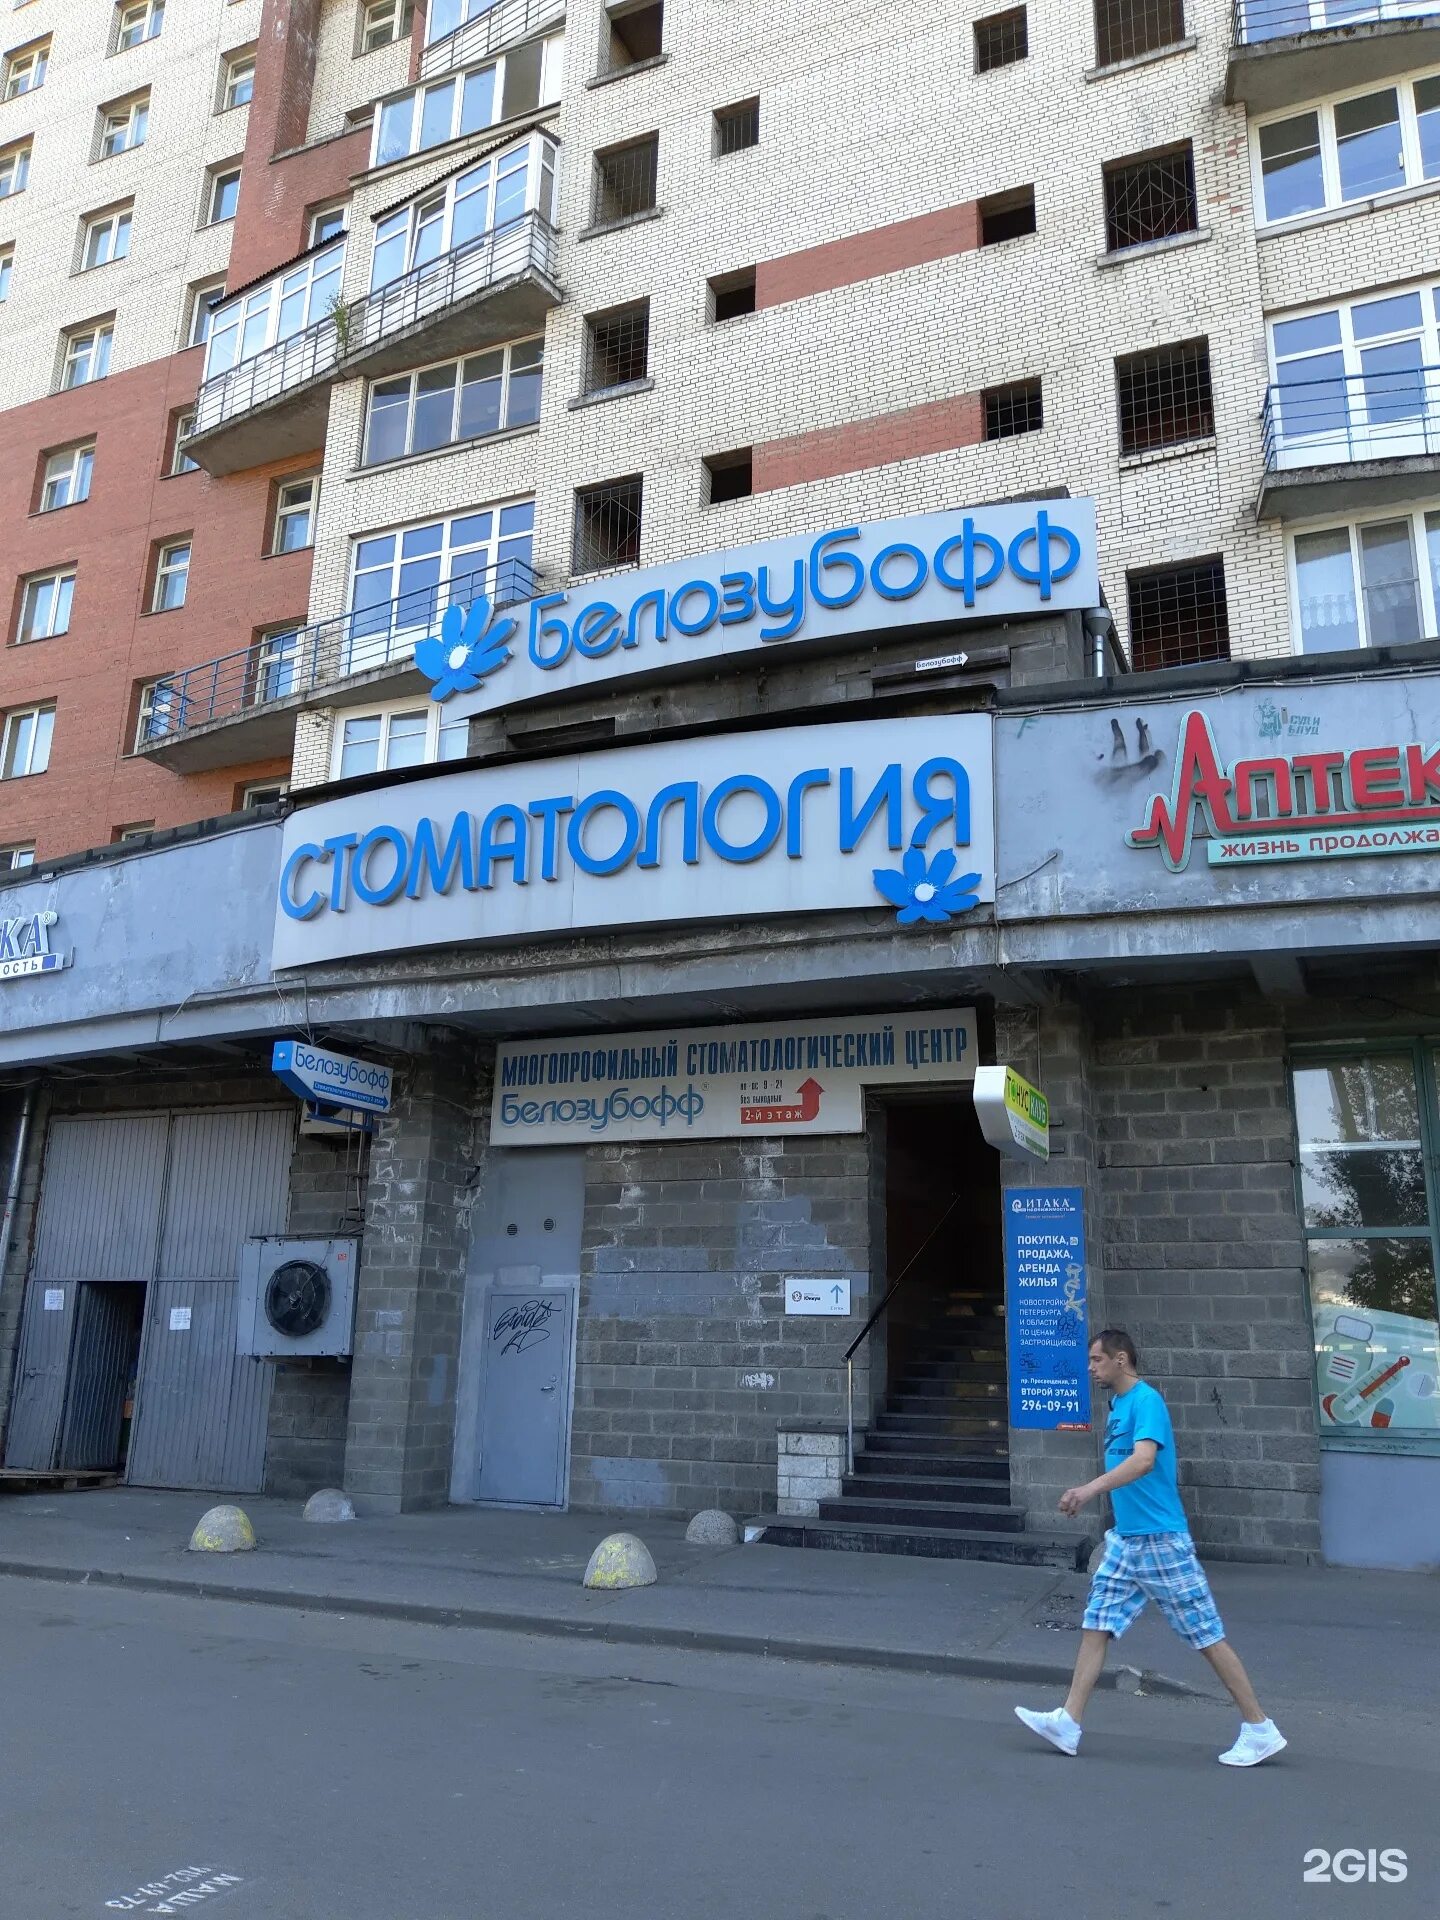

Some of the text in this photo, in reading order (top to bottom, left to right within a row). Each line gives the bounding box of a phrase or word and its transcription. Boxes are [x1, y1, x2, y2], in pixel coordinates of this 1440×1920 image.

[528, 508, 1082, 670] Белозубофф
[279, 756, 971, 921] СТОМАТОЛОГИЯ
[502, 1025, 968, 1087] МНОГОПРОФИЛЬНЫЙ СТОМАТОЛОГИЧЕСКИЙ ЦЕНТР
[295, 1045, 390, 1094] Белозубофф
[500, 1084, 705, 1132] Белозубофф
[745, 1110, 803, 1121] 2-й этаж
[1026, 1198, 1070, 1208] ИТАКА
[1017, 1235, 1069, 1246] ПОКУПКА,
[1017, 1249, 1073, 1260] ПРОДАЖА,
[1018, 1263, 1060, 1274] АРЕНДА
[1018, 1277, 1058, 1287] ЖИЛЬЯ
[1030, 1329, 1056, 1337] ЦЕНАМ
[1020, 1339, 1077, 1347] ЗАСТРОЙЩИКОВ
[1021, 1387, 1078, 1397] ВТОРОЙ ЭТАЖ
[1021, 1399, 1079, 1412] 296-09-91
